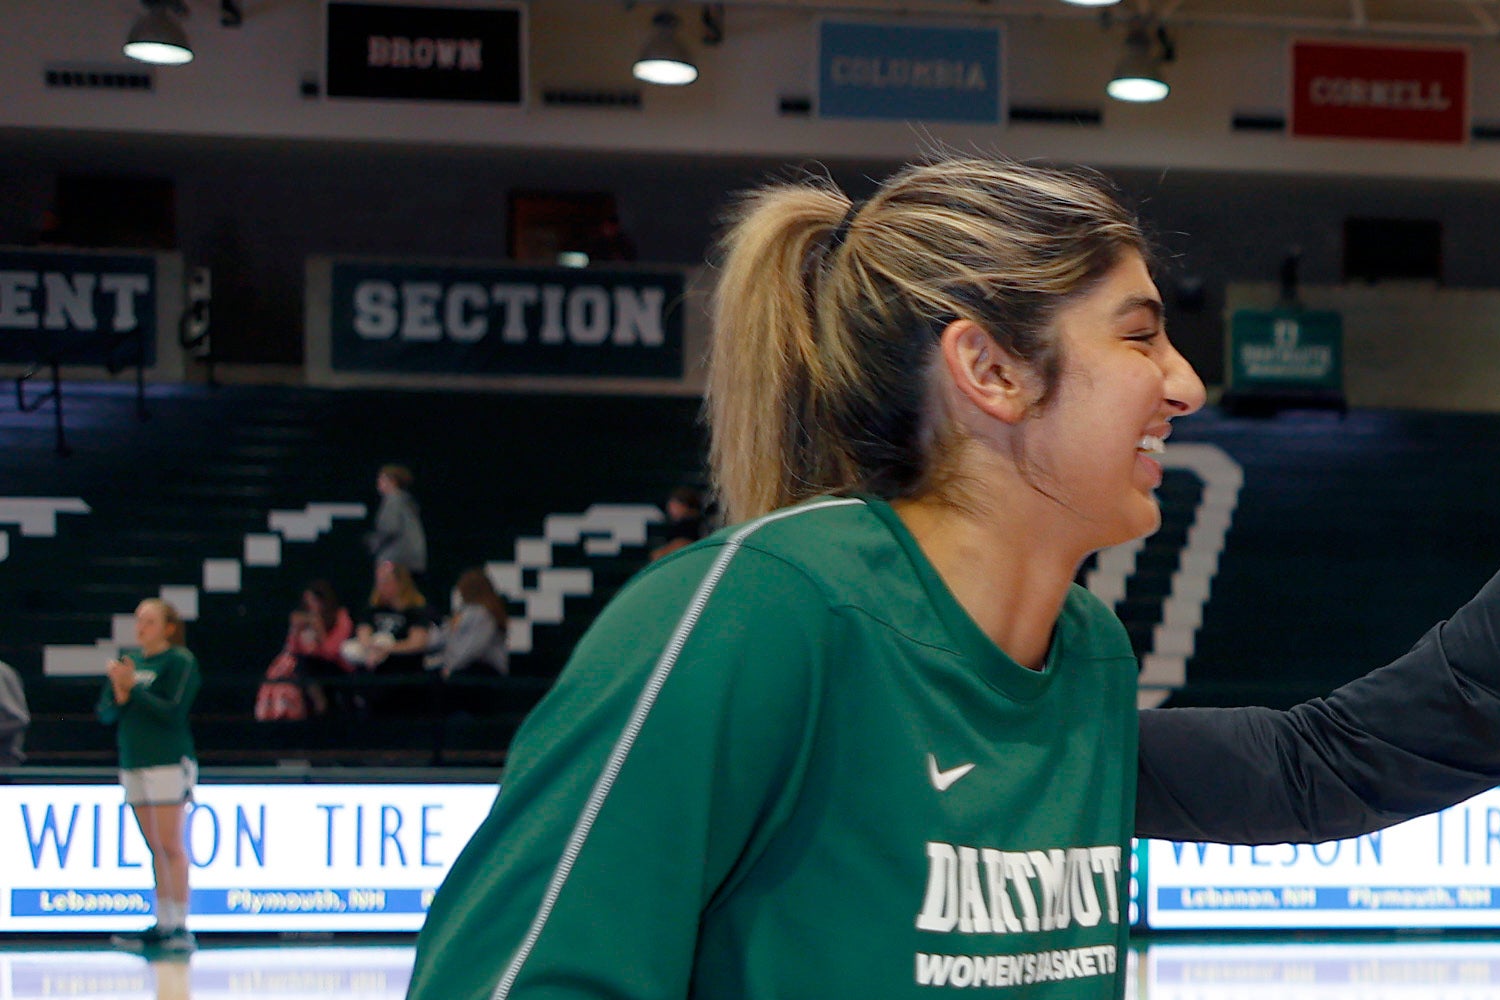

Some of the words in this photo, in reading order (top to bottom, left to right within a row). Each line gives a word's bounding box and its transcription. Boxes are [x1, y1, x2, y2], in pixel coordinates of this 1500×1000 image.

[368, 36, 482, 70] BROWN
[831, 56, 987, 90] COLUMBIA
[1310, 77, 1451, 111] CORNELL
[354, 280, 665, 346] SECTION
[20, 804, 265, 869] WILON
[316, 804, 444, 868] TIRE
[40, 891, 151, 912] Lebanon,
[227, 890, 347, 914] Plymouth,
[916, 953, 1037, 987] WOMEN'S
